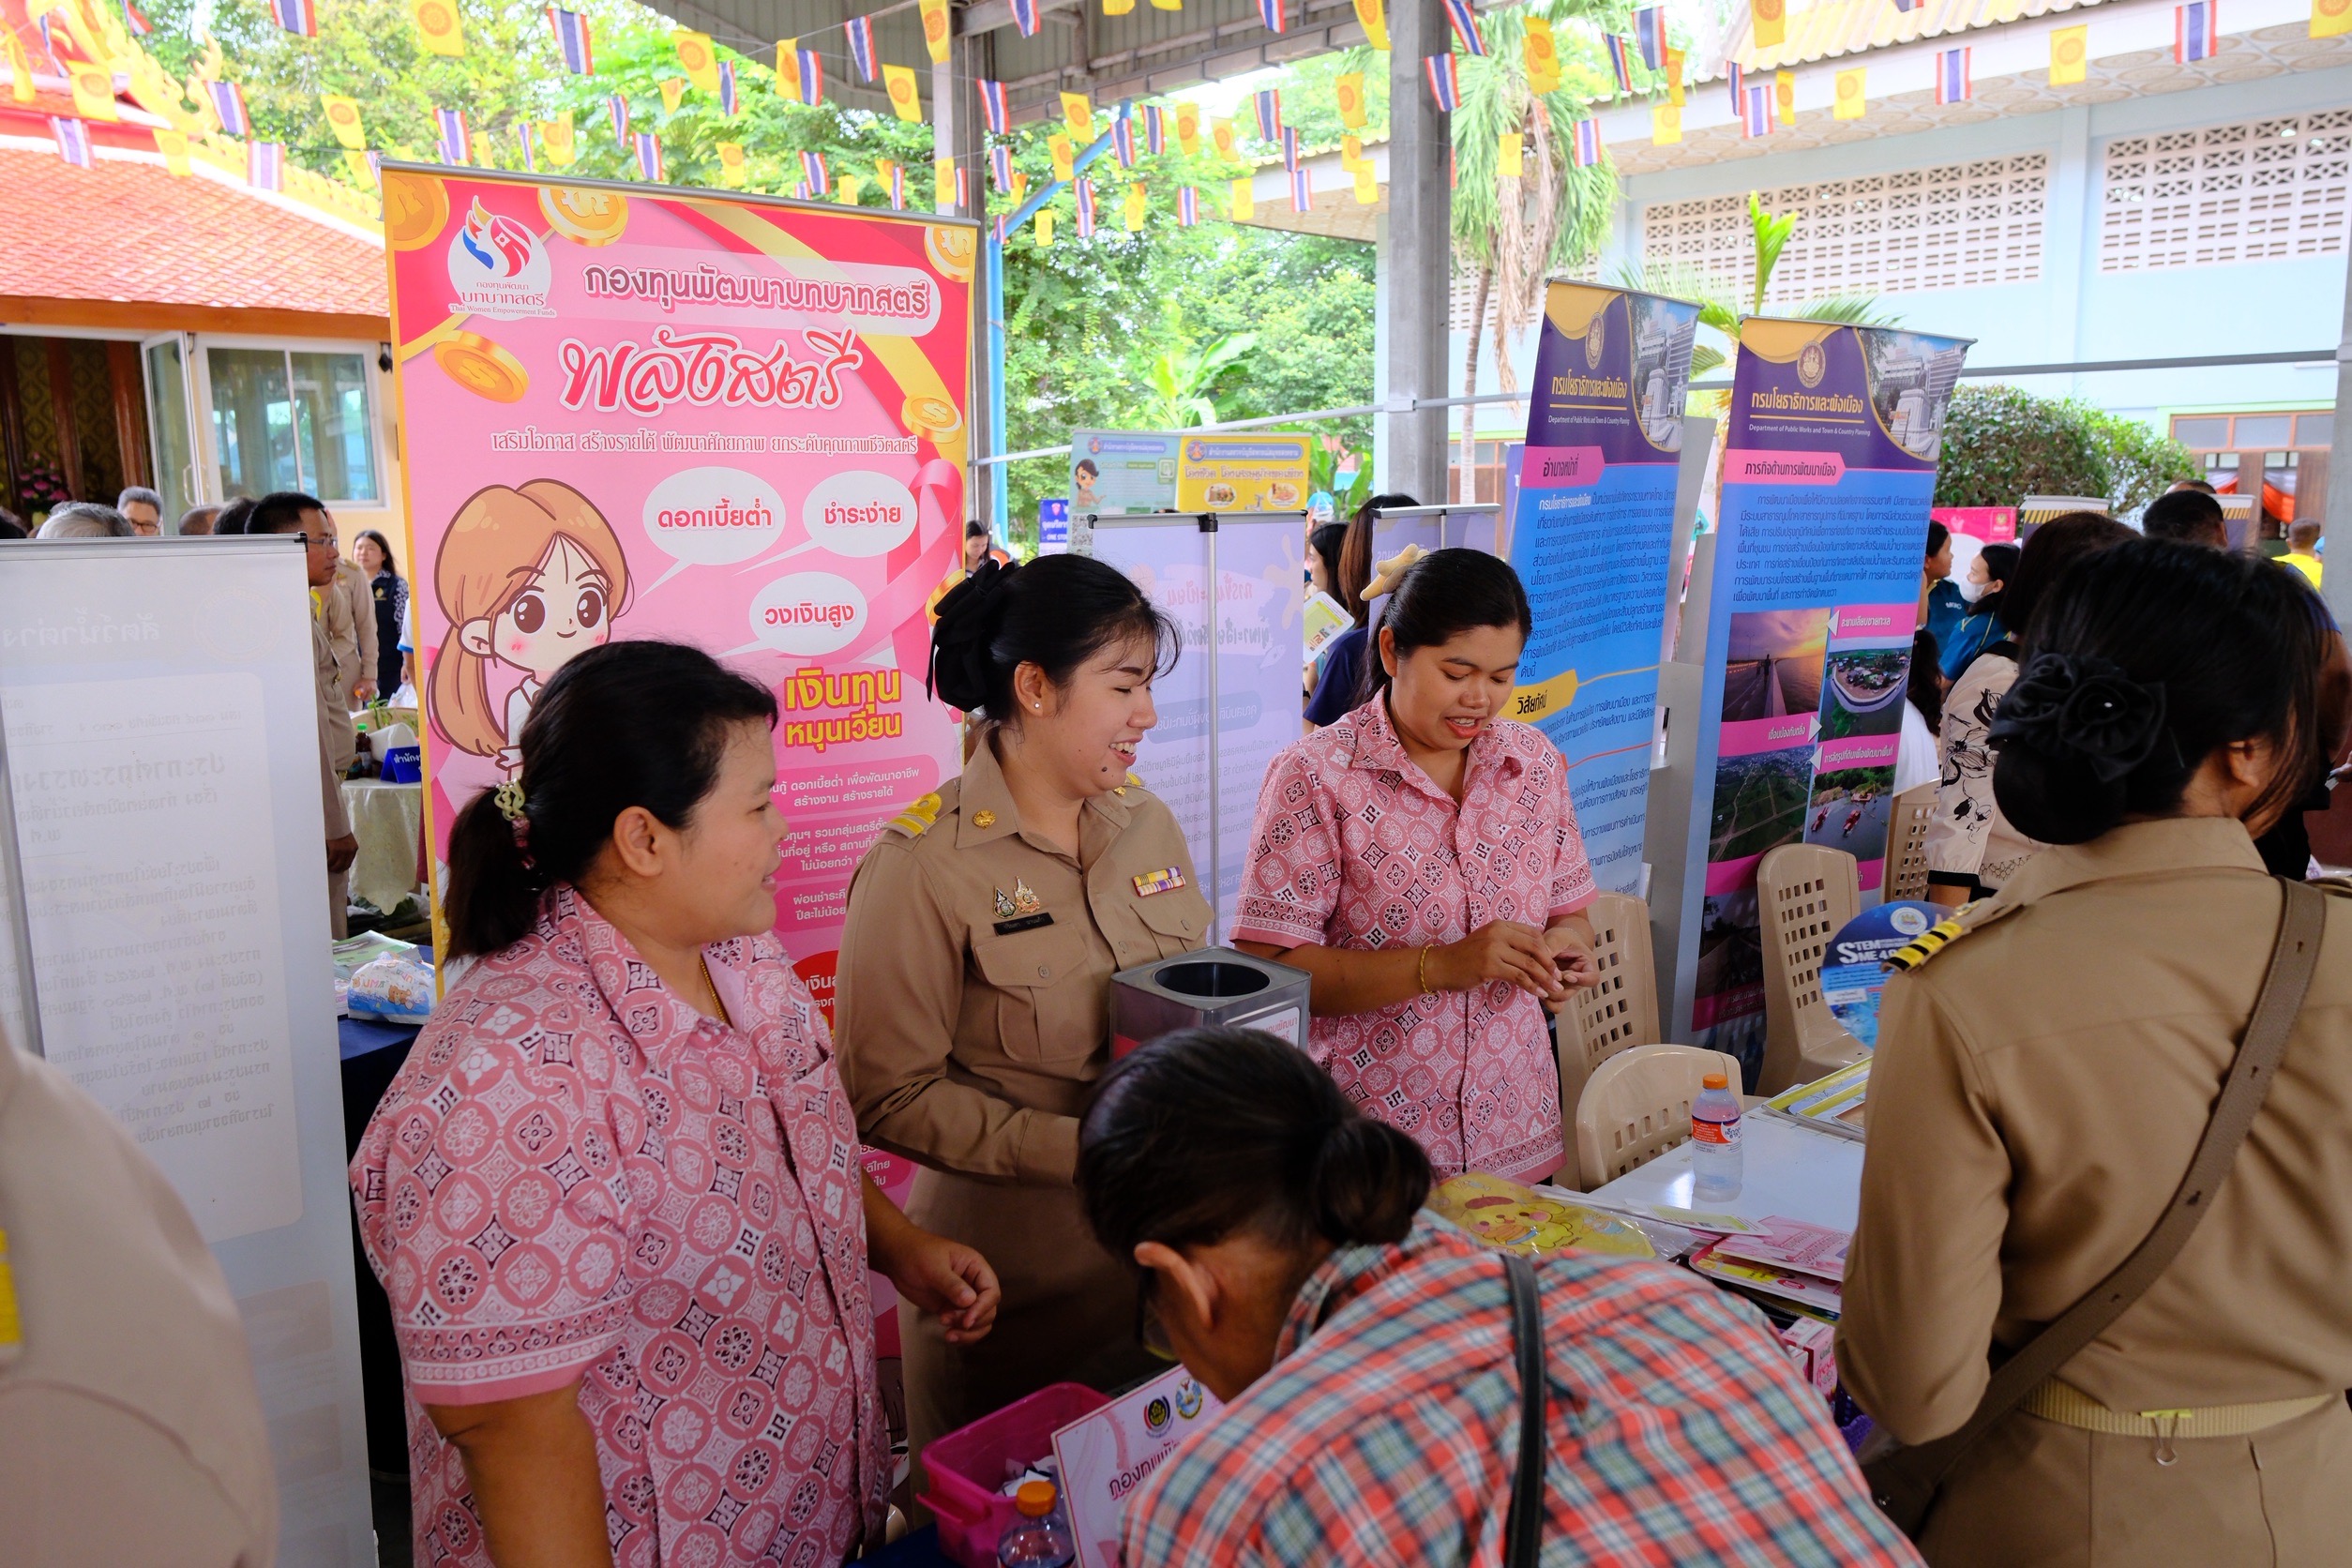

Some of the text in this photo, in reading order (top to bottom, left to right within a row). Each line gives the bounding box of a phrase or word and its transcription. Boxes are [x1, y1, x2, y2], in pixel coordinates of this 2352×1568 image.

[476, 281, 529, 290] กองทุนพัฒนา
[581, 262, 929, 316] กองทุนพัฒนาบทบาทสตรี
[462, 292, 544, 306] บทบาทสตรี
[492, 307, 535, 315] Empowerment
[560, 325, 862, 415] พลังสตรี
[1551, 369, 1627, 400] กรมโยธาธิการและผังเมือง
[1752, 386, 1863, 415] กรมโยธาธิการและผังเมือง
[1548, 415, 1570, 424] Department
[1749, 424, 1778, 432] Department
[1838, 428, 1854, 437] Country
[1855, 429, 1870, 437] Planning
[491, 427, 918, 457] เสริมโอกาส สร้างรายได้ พัฒนาศักยภาพ ยกระดับคุณภาพชีวิตสตรี
[1744, 461, 1836, 477] ภารกิจด้านการพัฒนาเมือง
[657, 497, 901, 529] ดอกเบี้ยต่ำ ชำระง่าย
[1739, 524, 1760, 537] ได้เสีย
[1736, 558, 1760, 569] ประเทศ
[764, 603, 854, 627] วงเงินสูง
[1520, 661, 1537, 678] ดังนี้
[785, 668, 900, 714] เงินทุน
[1516, 689, 1548, 716] วิสัยทัศน์
[786, 711, 901, 752] หมุนเวียน
[791, 774, 843, 792] ดอกเบี้ยต่ำ
[848, 767, 919, 786] เพื่อพัฒนาอาชีพ
[793, 786, 894, 807] สร้างงาน สร้างรายได้
[815, 817, 887, 838] รวมกลุ่มสตรีตั้
[815, 841, 836, 854] หรือ
[801, 856, 852, 871] ไม่น้อยกว่า
[793, 888, 846, 905] ผ่อนชำระคื
